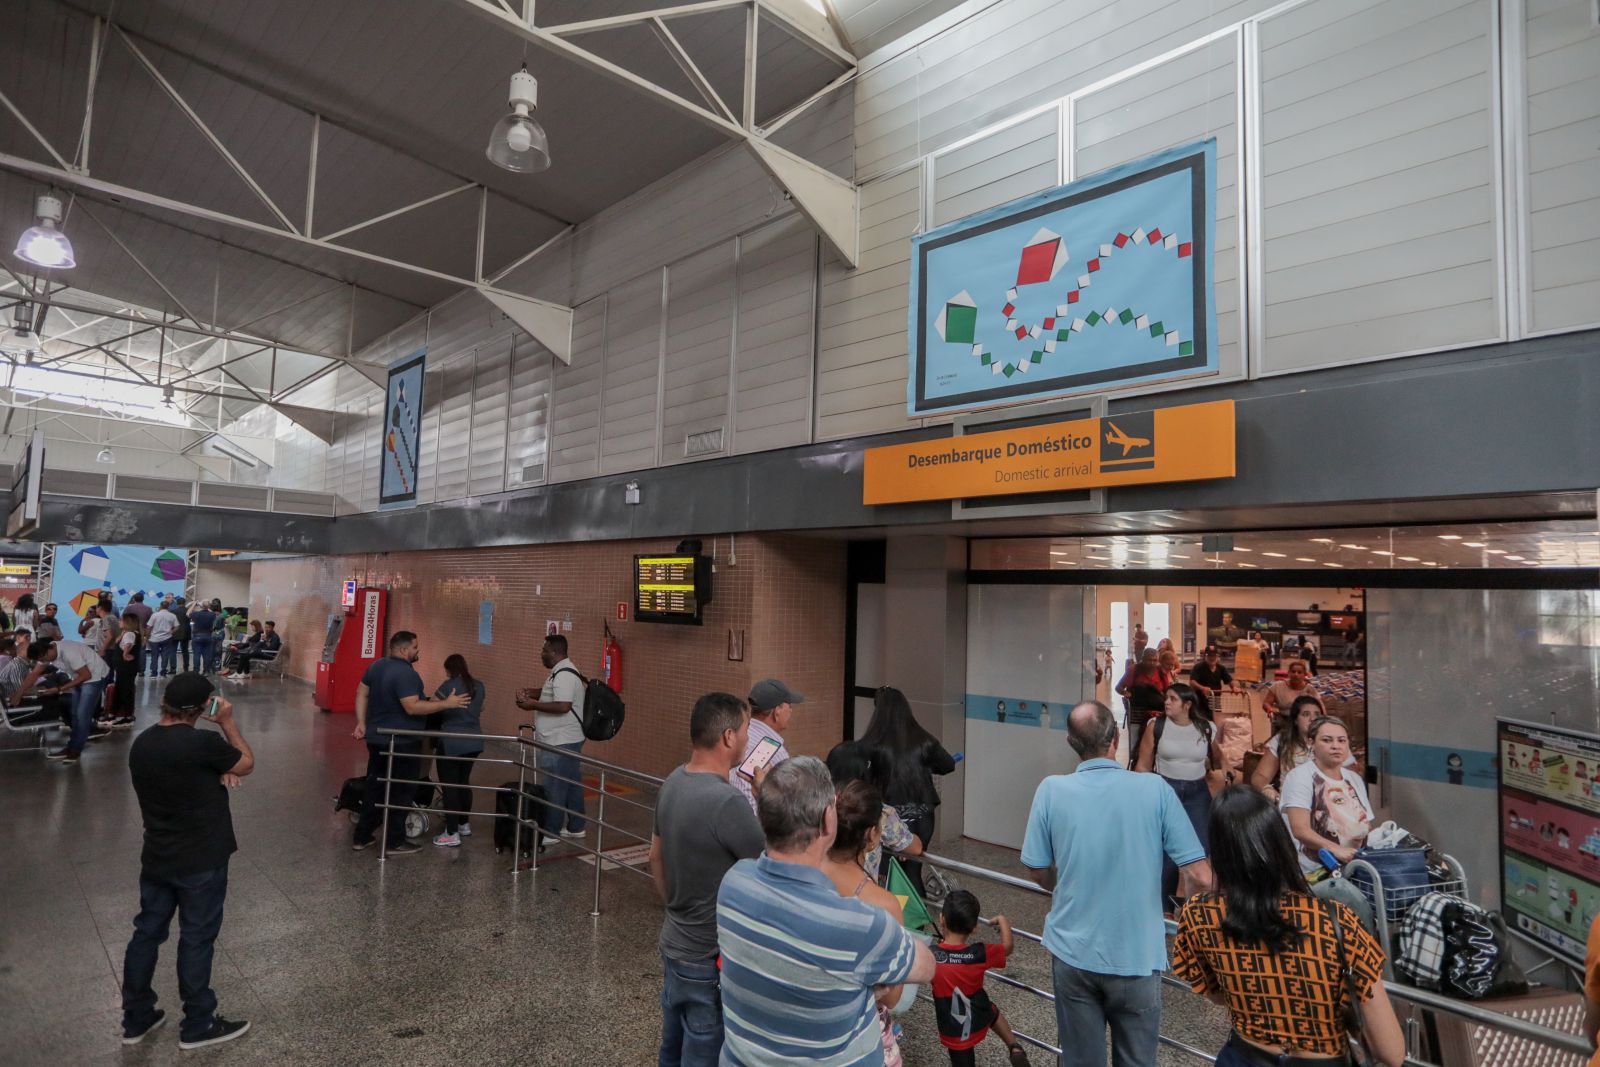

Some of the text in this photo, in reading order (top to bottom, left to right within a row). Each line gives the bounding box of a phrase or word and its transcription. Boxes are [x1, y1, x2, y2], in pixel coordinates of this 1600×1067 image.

[908, 434, 1092, 468] Desembarque Doméstico
[995, 461, 1092, 483] Domestic arrival
[365, 595, 377, 655] Banco24Horas
